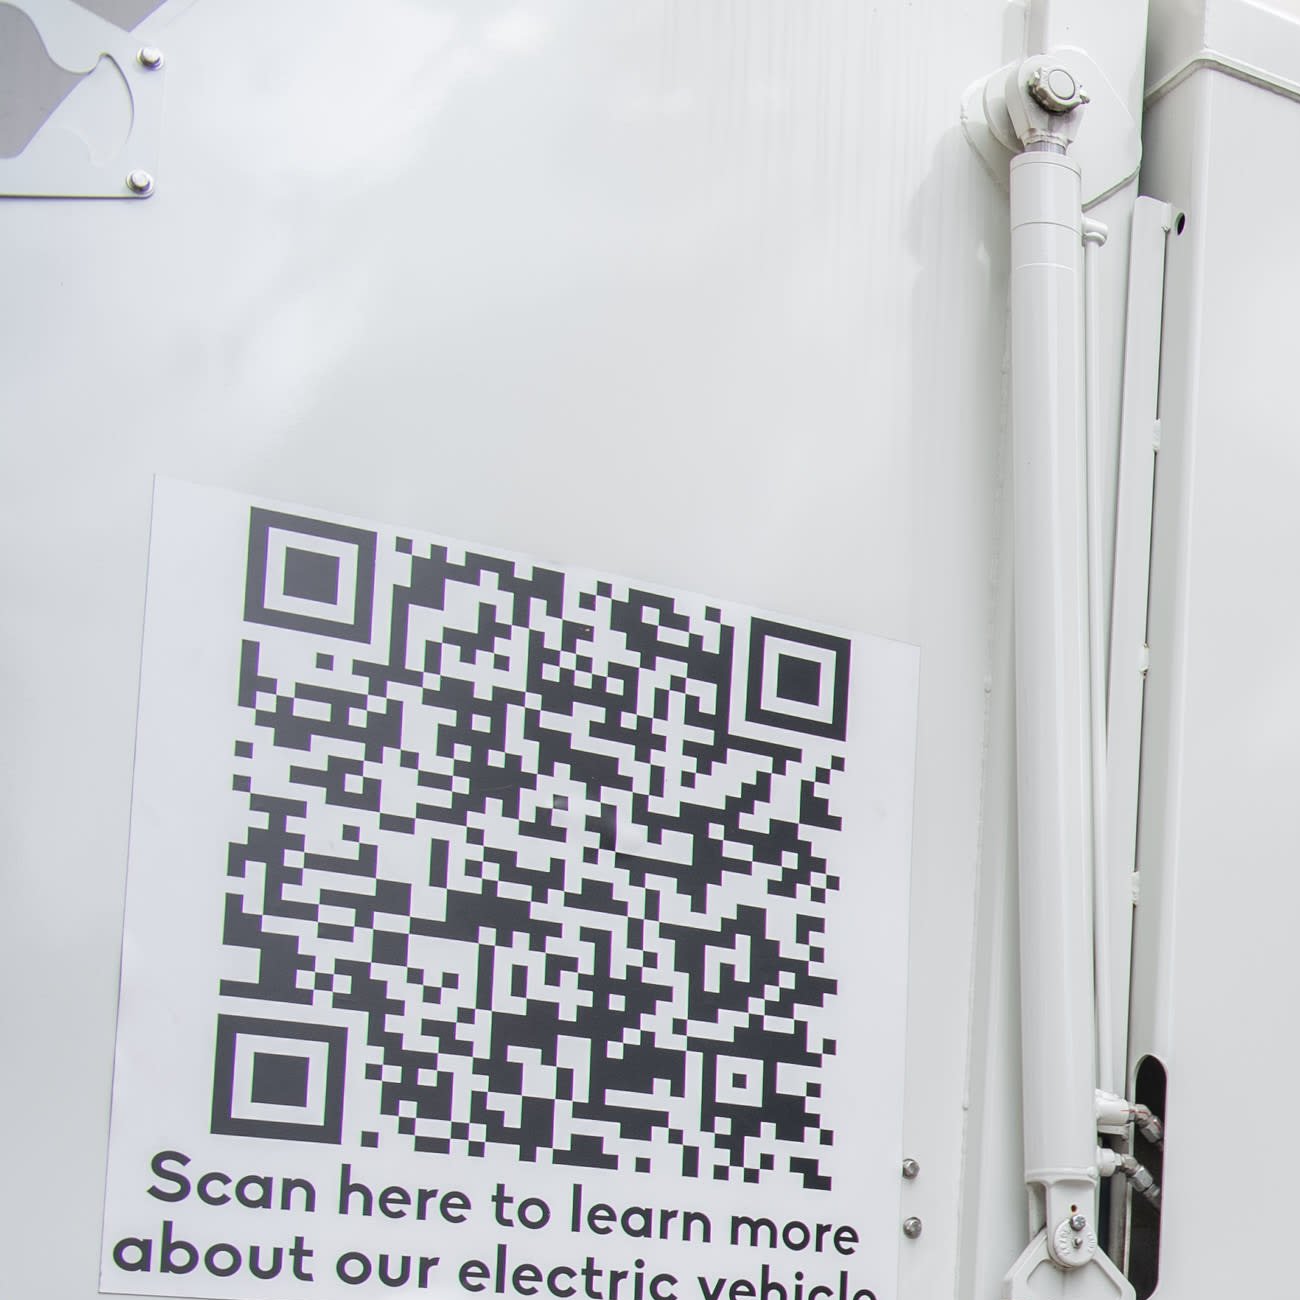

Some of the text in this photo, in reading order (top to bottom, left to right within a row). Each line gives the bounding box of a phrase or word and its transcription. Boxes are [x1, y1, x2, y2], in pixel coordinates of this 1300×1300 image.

[145, 1150, 861, 1257] Scan here to learn more
[111, 1221, 316, 1282] about
[335, 1249, 441, 1290] our
